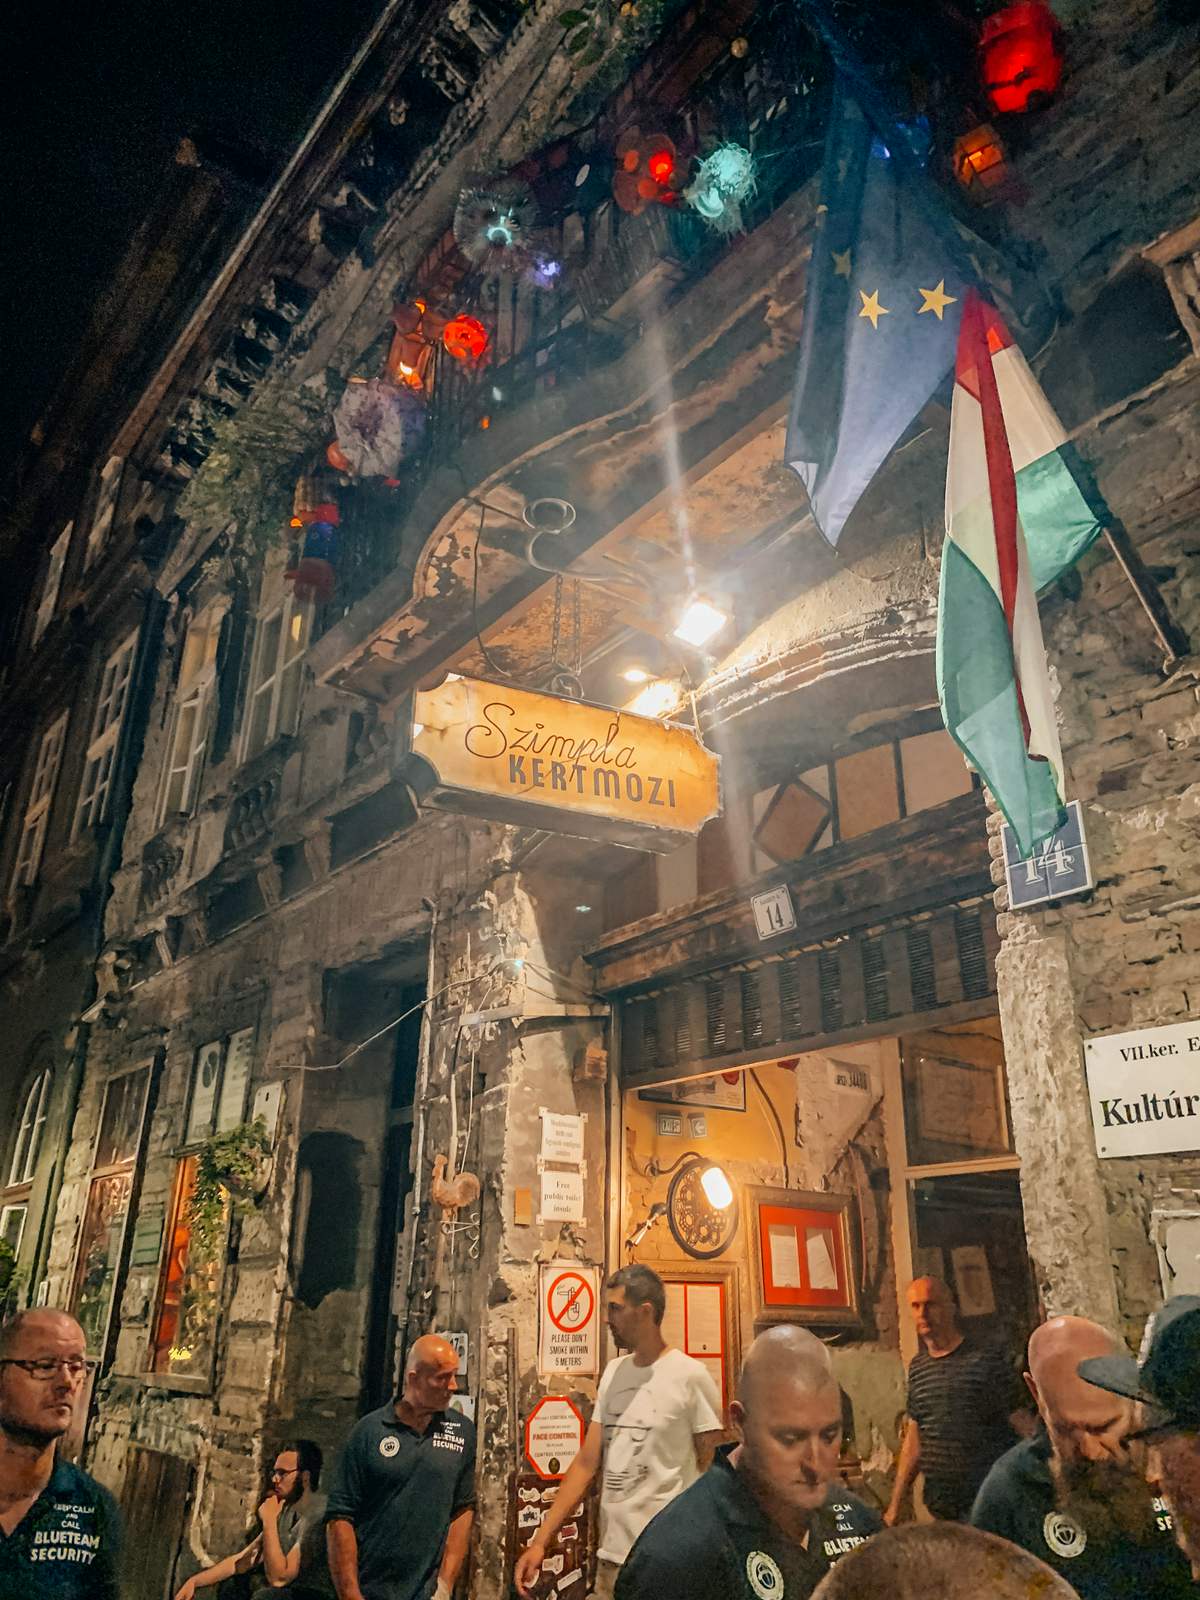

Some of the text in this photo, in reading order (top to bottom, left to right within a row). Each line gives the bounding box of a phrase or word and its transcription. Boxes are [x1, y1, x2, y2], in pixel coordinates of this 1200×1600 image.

[465, 702, 637, 783] Szimpla
[508, 754, 677, 808] KERTMOZI
[765, 902, 784, 931] 14
[1099, 1090, 1200, 1128] Kultúr
[551, 1333, 587, 1343] PLEASE DON'T
[549, 1344, 589, 1355] SMOKE WITHIN
[560, 1356, 582, 1367] METERS
[533, 1431, 577, 1441] FACE CONTROL
[432, 1439, 464, 1453] SECURITY
[72, 1505, 96, 1514] CALM
[61, 1520, 81, 1530] CALL
[34, 1531, 101, 1549] BLUETEAM
[30, 1547, 97, 1565] SECURITY
